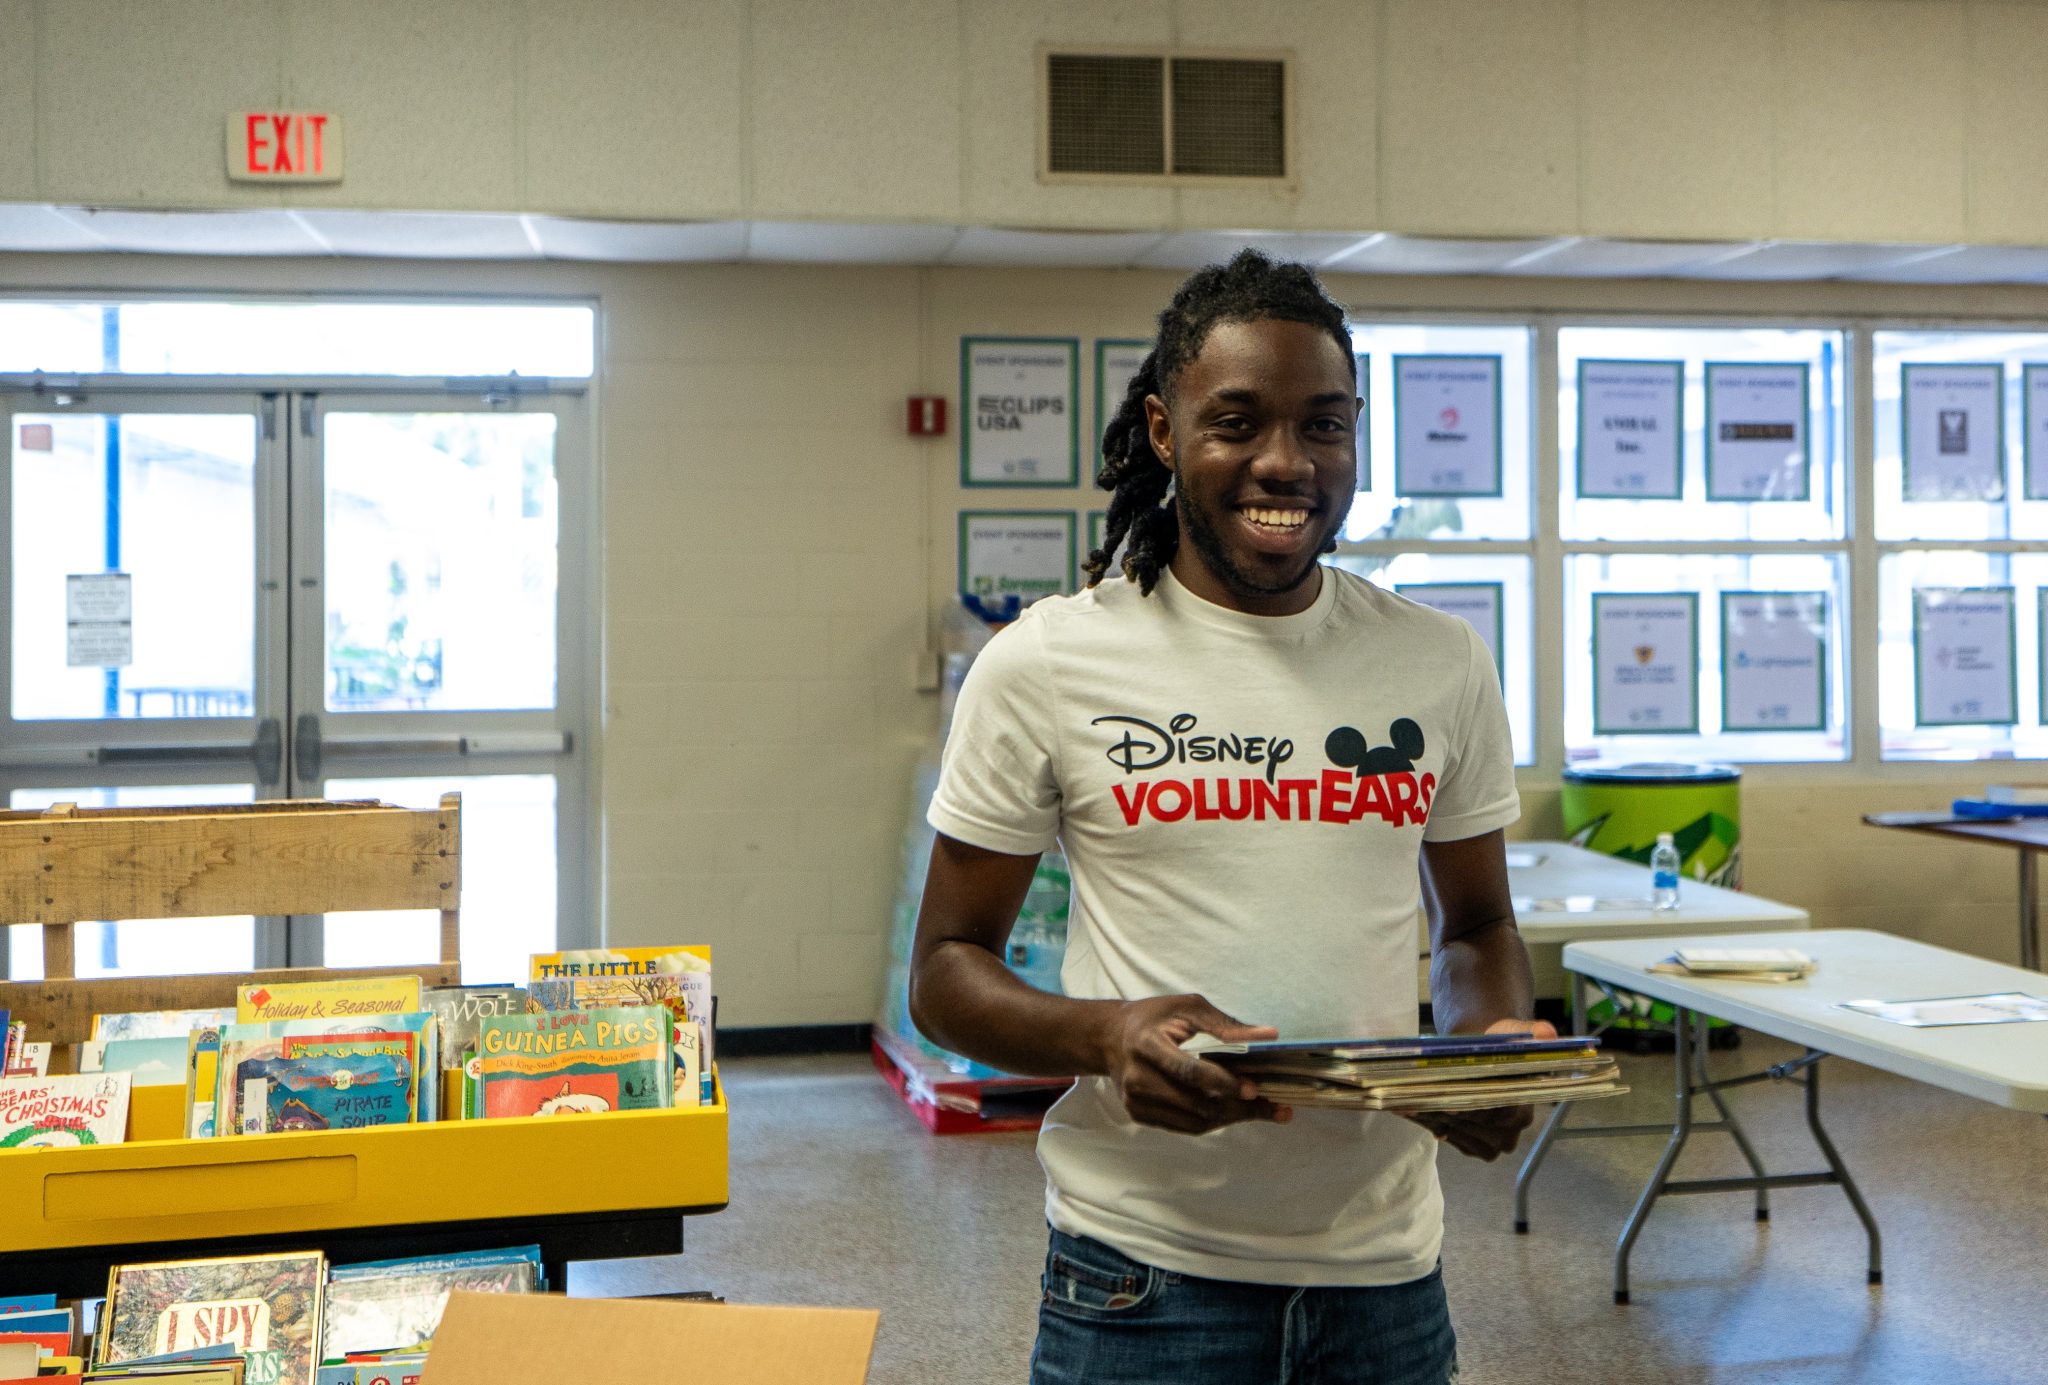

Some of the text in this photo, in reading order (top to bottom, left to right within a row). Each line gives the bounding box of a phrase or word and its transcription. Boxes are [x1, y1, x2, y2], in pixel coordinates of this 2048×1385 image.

[246, 113, 328, 175] EXIT
[978, 415, 1021, 431] USA
[1091, 713, 1294, 785] Disney
[1111, 769, 1436, 828] VOLUNTEARS
[540, 960, 657, 979] THE LITTLE
[253, 1002, 307, 1019] Holiday
[311, 1000, 325, 1018] &
[331, 996, 407, 1015] Seasonal
[451, 1000, 517, 1021] WOLF
[537, 1014, 588, 1031] I LOVE
[485, 1017, 658, 1054] GUINEA PIGS
[496, 1059, 513, 1067] Dick
[5, 1096, 108, 1123] CHRISTMAS
[335, 1095, 393, 1112] PIRATE
[341, 1114, 387, 1128] SOUP
[167, 1304, 262, 1352] I SPY
